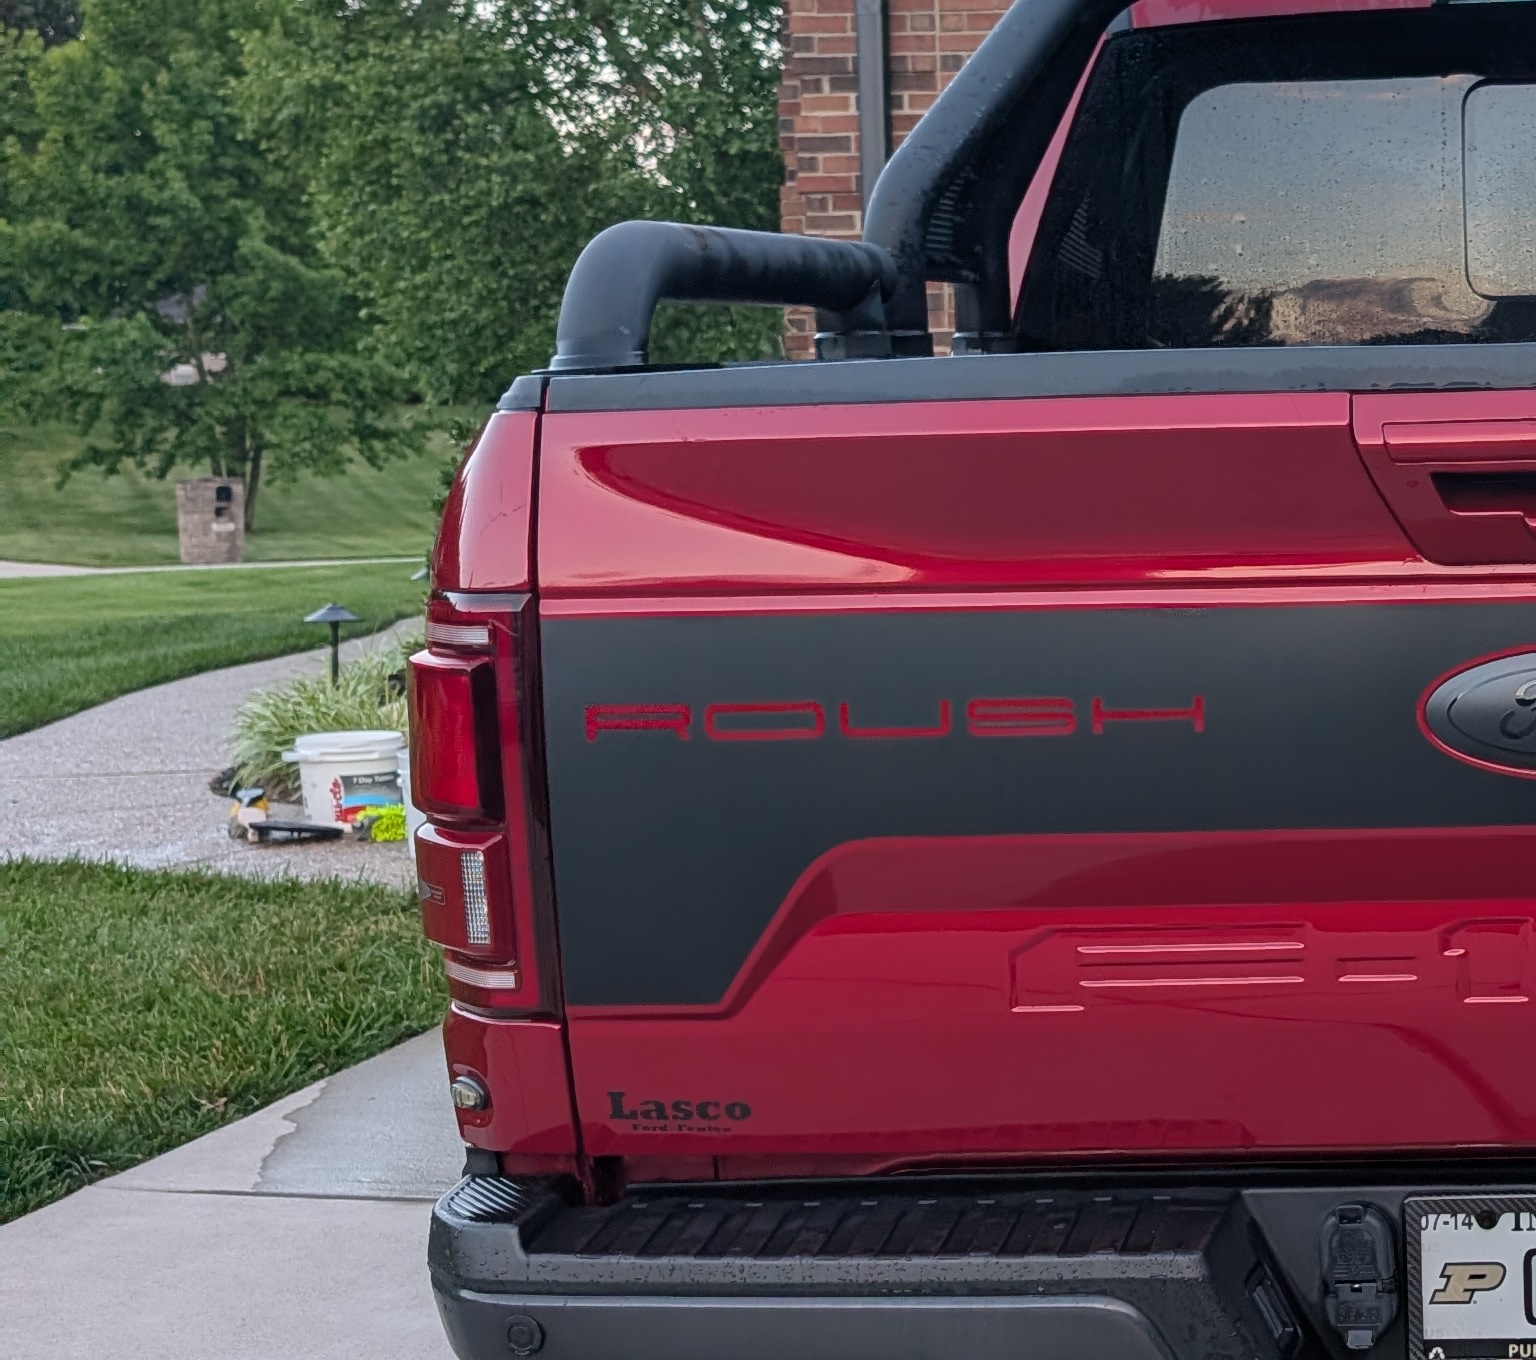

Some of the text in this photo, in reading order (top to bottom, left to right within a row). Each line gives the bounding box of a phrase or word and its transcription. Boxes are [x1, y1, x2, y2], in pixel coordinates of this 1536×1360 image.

[585, 696, 1205, 741] ROUSH
[607, 1091, 752, 1121] Lasco
[1428, 1262, 1507, 1305] P
